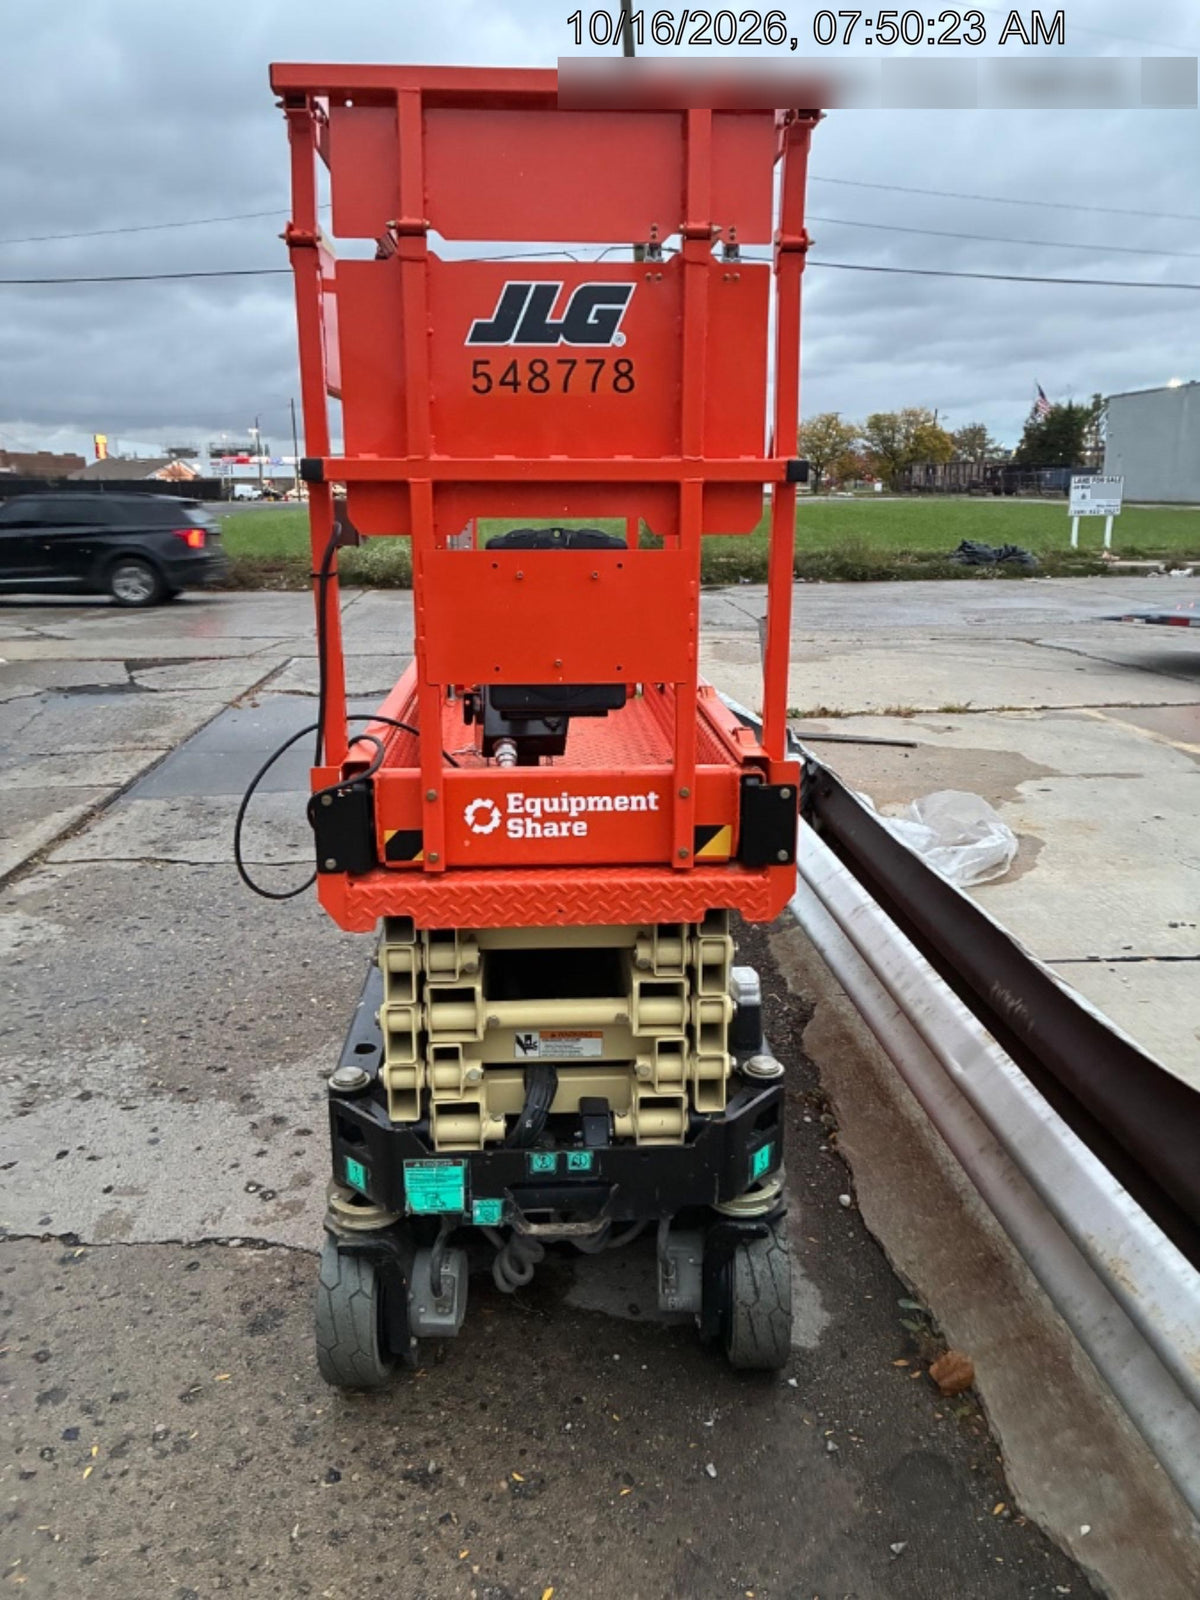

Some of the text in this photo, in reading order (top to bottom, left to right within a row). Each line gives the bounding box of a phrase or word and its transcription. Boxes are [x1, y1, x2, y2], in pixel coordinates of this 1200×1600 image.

[472, 359, 635, 394] 548778
[506, 791, 660, 818] Equipment
[506, 817, 588, 839] Share
